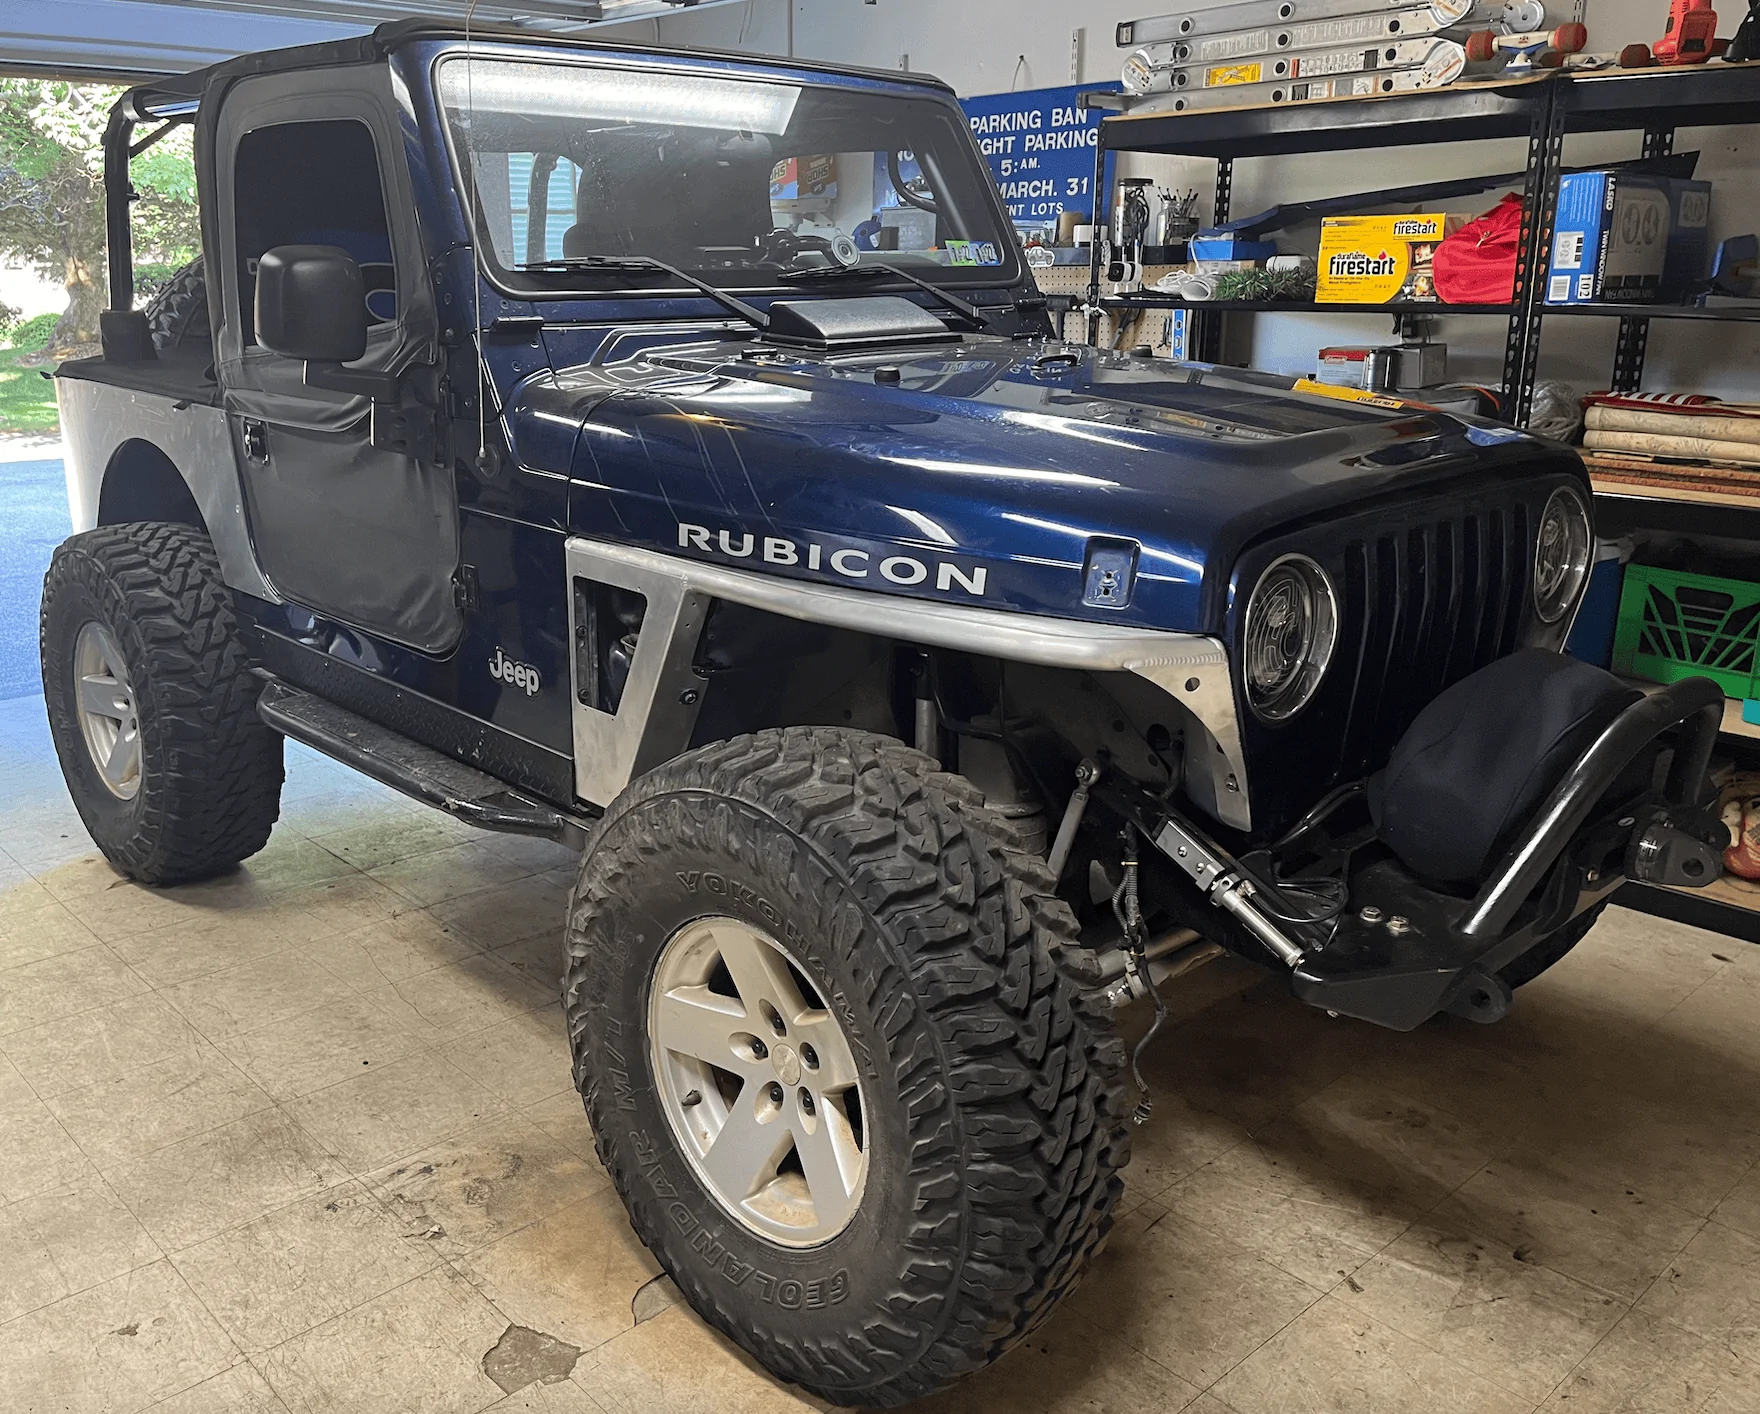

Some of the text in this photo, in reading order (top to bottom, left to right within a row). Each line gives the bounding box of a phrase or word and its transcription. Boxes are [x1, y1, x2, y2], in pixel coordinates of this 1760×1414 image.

[970, 107, 1088, 134] PARKING BAN
[977, 128, 1099, 156] GHT PARKING
[806, 165, 829, 184] SHOP
[1066, 177, 1088, 196] 31
[1605, 177, 1616, 211] LASKO
[1006, 202, 1064, 217] NT LOTS
[1393, 222, 1437, 235] firestart
[1329, 256, 1396, 275] firestart
[1579, 276, 1592, 297] 102
[677, 522, 988, 597] RUBICON
[488, 647, 541, 697] Jeep
[676, 870, 878, 1078] YOKOHAMA
[603, 1014, 638, 1112] M/T
[628, 1127, 851, 1311] GEOLANDAR
